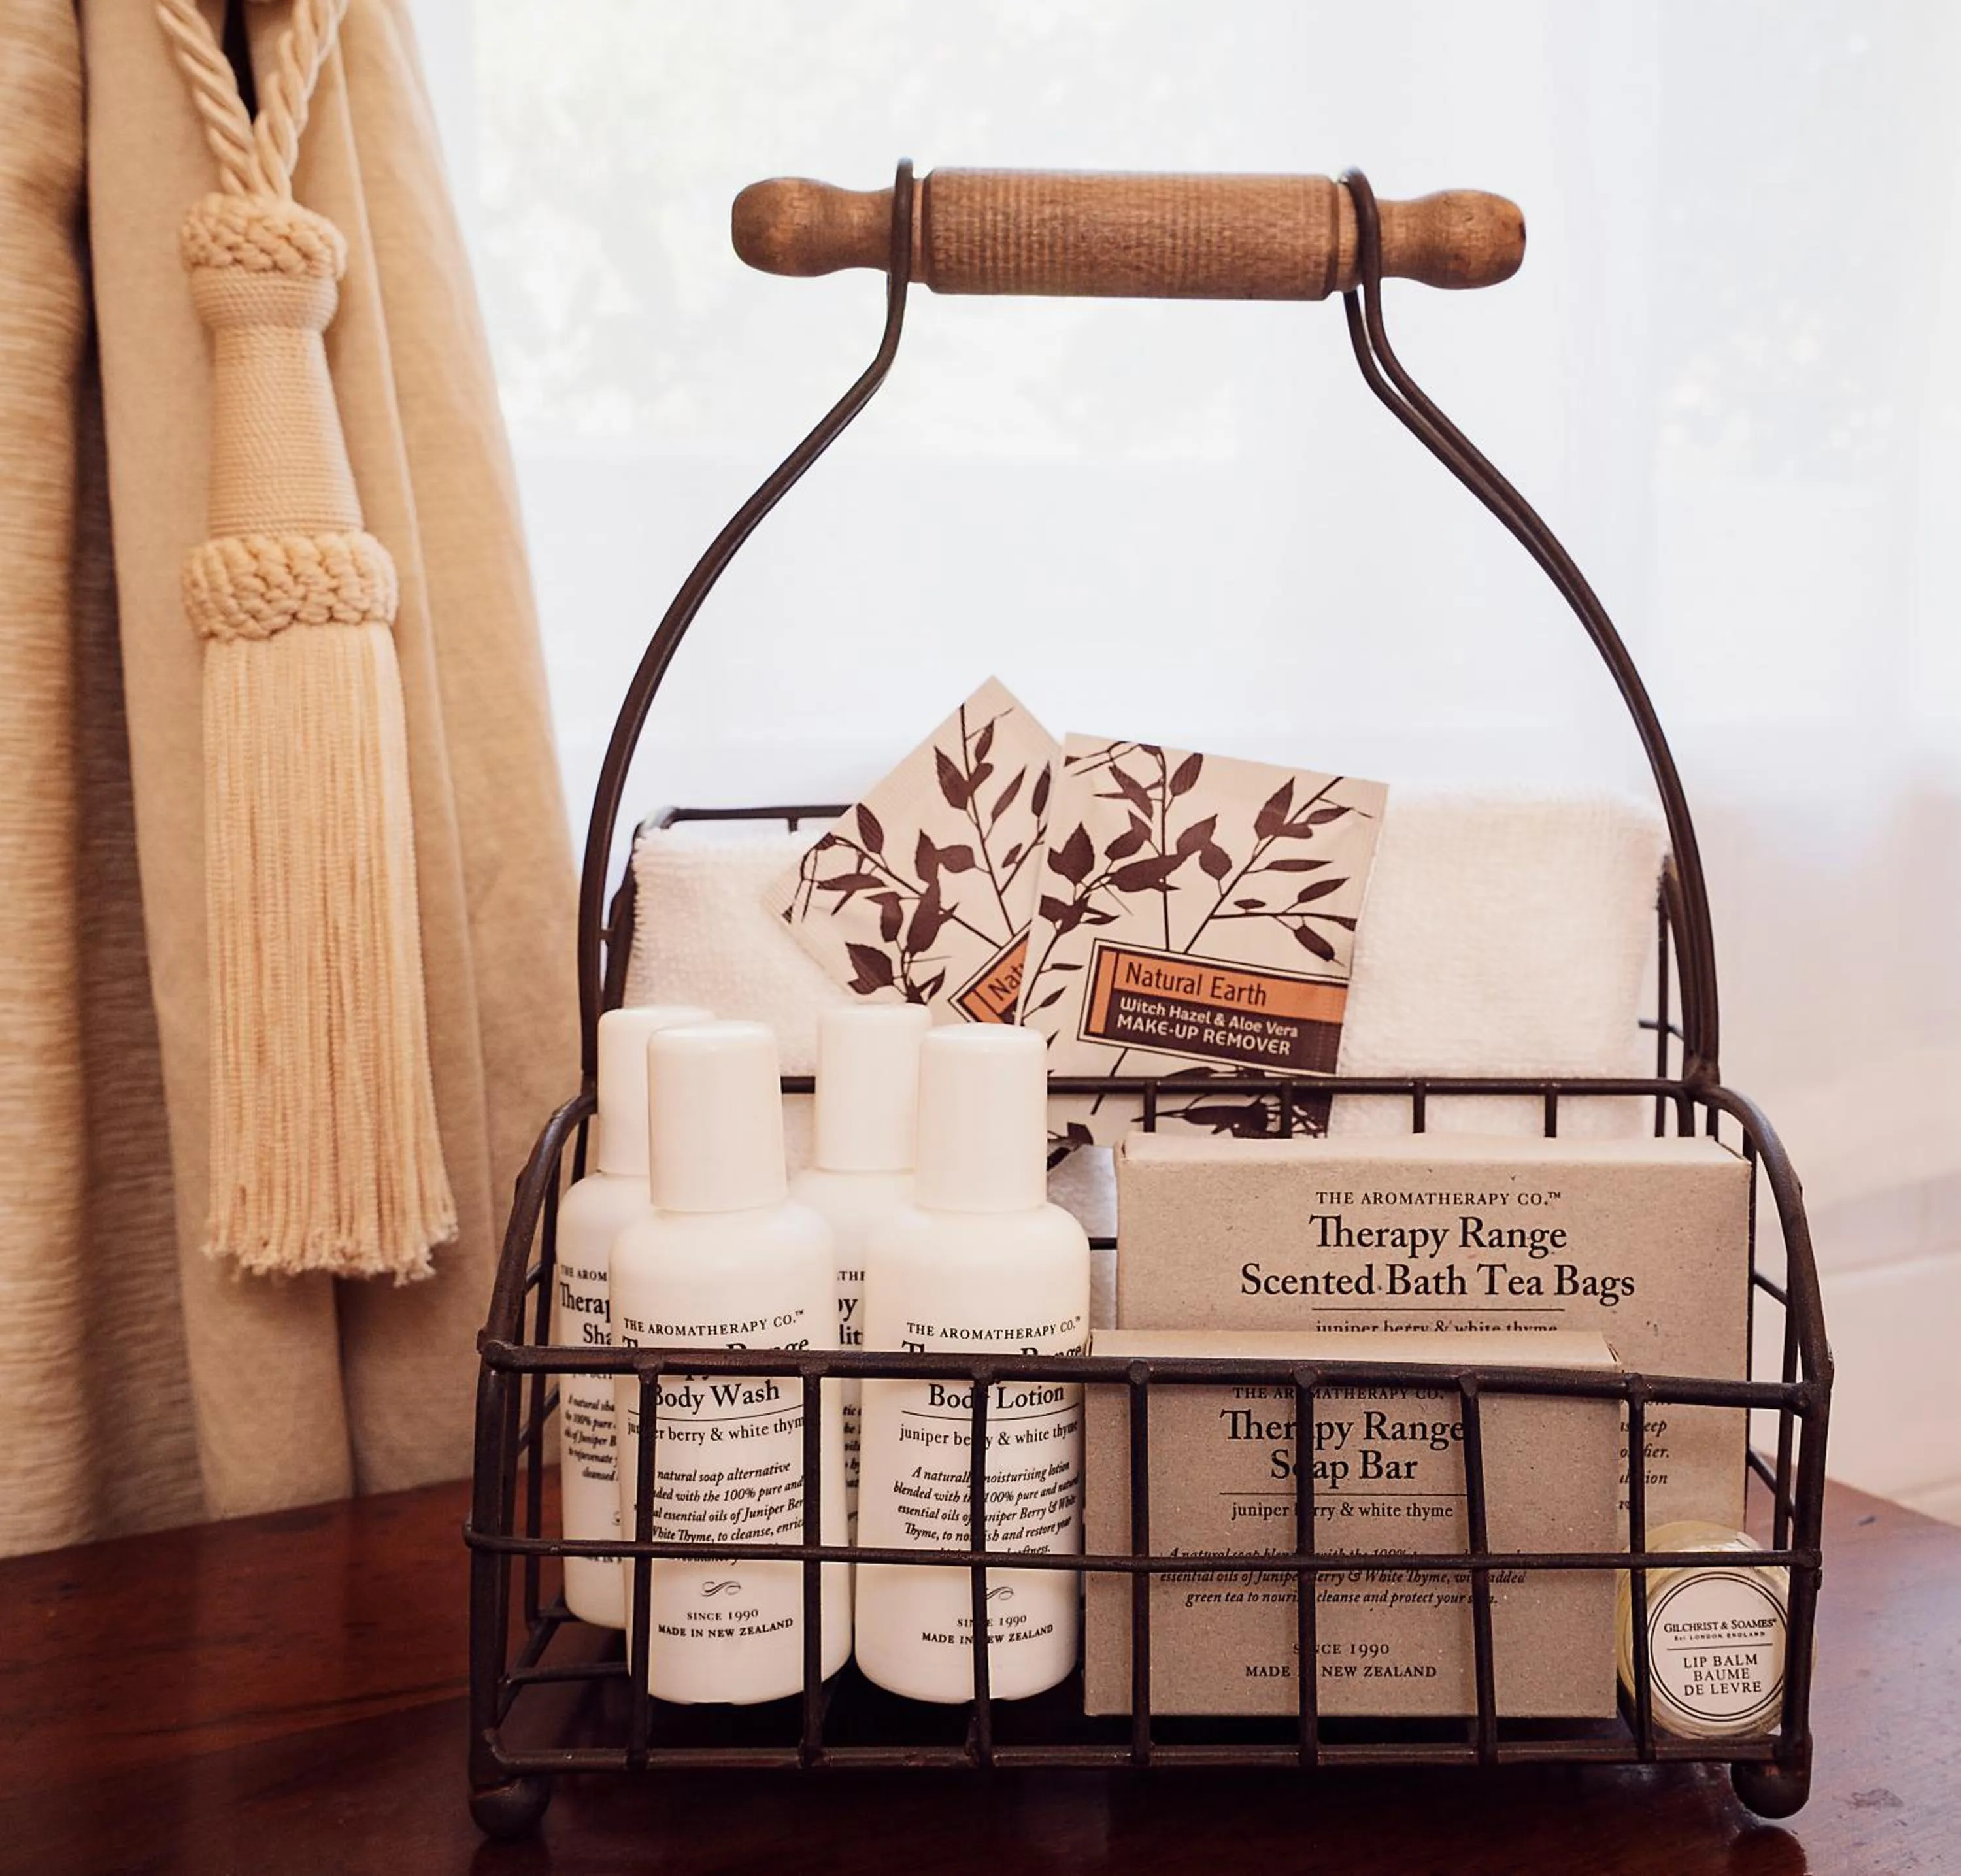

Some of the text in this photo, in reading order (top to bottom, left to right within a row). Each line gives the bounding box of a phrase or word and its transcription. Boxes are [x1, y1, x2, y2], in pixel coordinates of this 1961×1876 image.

[988, 963, 1024, 1001] Nat
[1126, 962, 1267, 1007] Natural Earth
[1120, 997, 1298, 1038] Witch Hazel & Aloe Vera
[1117, 1014, 1291, 1056] MAKE-UP REMOVER
[1316, 1192, 1354, 1205] THE
[1361, 1192, 1510, 1205] AROMATHERAPY
[1309, 1214, 1567, 1259] Therapy Range
[1241, 1262, 1635, 1307] Scented Bath Tea Bags
[624, 1317, 645, 1333] THE
[648, 1319, 767, 1336] AROMATHERAPY
[907, 1322, 934, 1337] THE
[939, 1324, 1056, 1340] AROMATHERAPY
[709, 1379, 780, 1407] Wash
[929, 1383, 1064, 1409] Bod Lotion
[1233, 1387, 1267, 1399] THE
[1273, 1387, 1407, 1399] ARMATHERAPY
[668, 1426, 705, 1446] berry
[711, 1427, 723, 1441] &
[728, 1423, 769, 1439] white
[899, 1420, 1079, 1450] juniper bey & white thyme
[1220, 1409, 1464, 1450] Therpy Range
[657, 1462, 792, 1486] natural soap alternative
[911, 1466, 922, 1478] A
[923, 1469, 972, 1488] naturall
[1048, 1461, 1070, 1477] lotion
[1271, 1449, 1418, 1489] Sap Bar
[675, 1490, 701, 1503] with
[703, 1490, 720, 1502] the
[724, 1487, 756, 1501] 100%
[758, 1485, 782, 1501] pure
[784, 1475, 803, 1492] and
[894, 1480, 933, 1499] blended
[933, 1490, 960, 1503] with
[1016, 1490, 1039, 1505] pure
[1040, 1481, 1057, 1497] and
[664, 1510, 707, 1522] essential
[709, 1509, 727, 1522] oils
[730, 1508, 743, 1524] of
[742, 1503, 785, 1522] Juniper
[897, 1505, 939, 1520] essential
[941, 1509, 960, 1521] oils
[1019, 1506, 1047, 1520] Berry
[1048, 1501, 1058, 1513] &
[1232, 1502, 1290, 1521] juniper
[1340, 1502, 1354, 1517] &
[1359, 1502, 1401, 1517] white
[1407, 1502, 1453, 1521] thyme
[678, 1528, 714, 1543] Thyme,
[718, 1530, 728, 1541] to
[731, 1526, 774, 1541] cleanse,
[905, 1521, 940, 1541] Thyme,
[942, 1530, 953, 1541] to
[1001, 1527, 1024, 1541] and
[1026, 1523, 1056, 1538] restore
[1055, 1516, 1072, 1535] your
[1160, 1571, 1214, 1583] essential
[1256, 1571, 1298, 1586] Junipe
[1317, 1572, 1345, 1587] erry
[1366, 1569, 1403, 1583] White
[1407, 1569, 1450, 1585] Thyme,
[1185, 1592, 1221, 1608] green
[1225, 1592, 1244, 1602] tea
[1247, 1592, 1258, 1602] to
[1316, 1590, 1360, 1603] cleanse
[1363, 1590, 1387, 1603] and
[1390, 1591, 1434, 1607] protect
[1436, 1594, 1465, 1607] your
[686, 1609, 759, 1622] SINCE 1990
[999, 1615, 1027, 1628] 1990
[658, 1618, 794, 1637] MADE IN NEW ZEALAND
[922, 1632, 954, 1643] MADE
[1009, 1624, 1054, 1642] ZEALAND
[1664, 1622, 1719, 1633] GILCHRIST
[1720, 1621, 1728, 1630] &
[1350, 1644, 1390, 1658] 1990
[1683, 1653, 1758, 1668] LIP BALM
[1245, 1666, 1437, 1677] MADE NEW ZEALAND
[1694, 1667, 1751, 1682] BAUME
[1684, 1681, 1762, 1696] DE LEVRE
